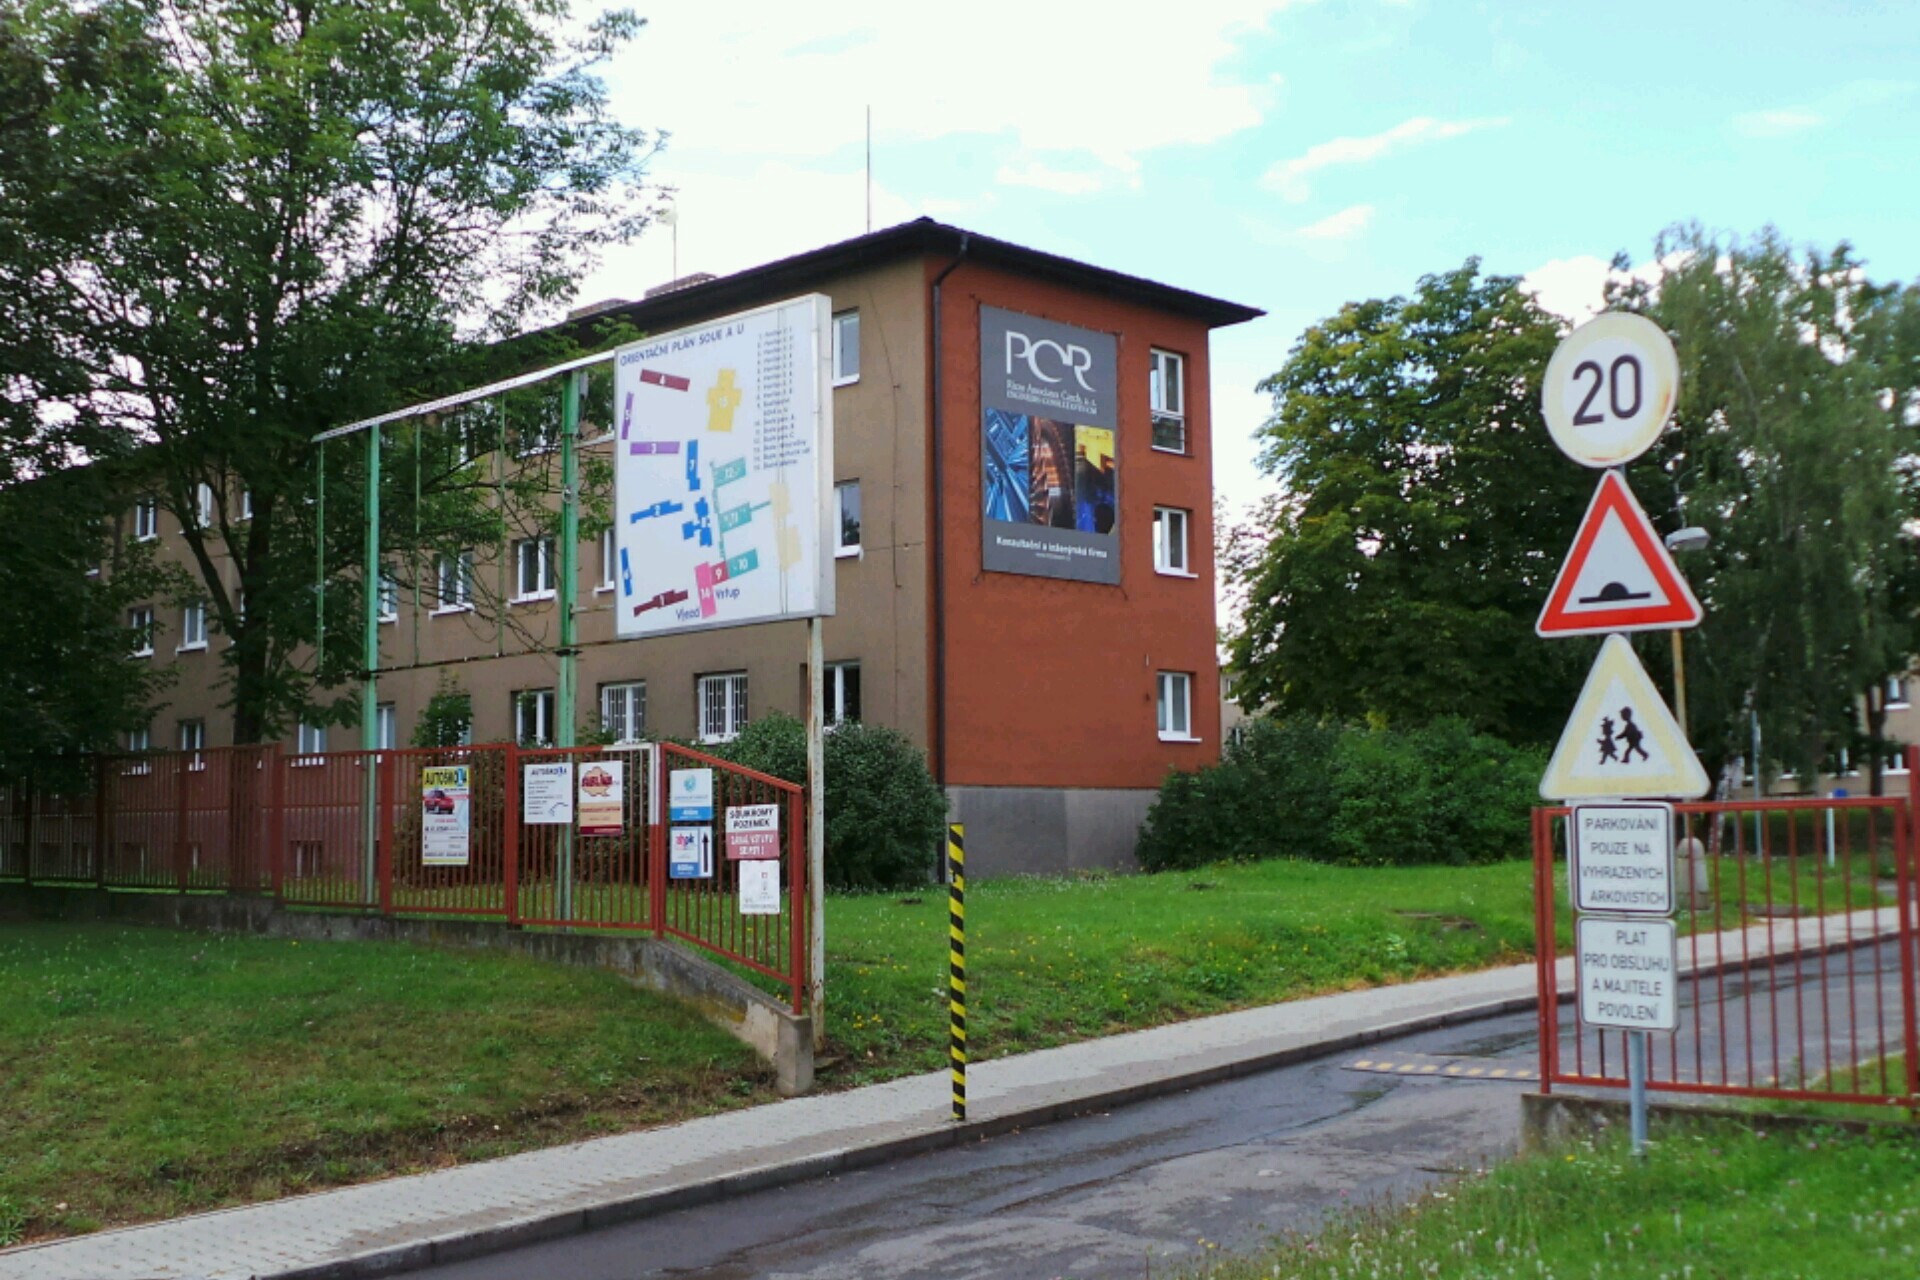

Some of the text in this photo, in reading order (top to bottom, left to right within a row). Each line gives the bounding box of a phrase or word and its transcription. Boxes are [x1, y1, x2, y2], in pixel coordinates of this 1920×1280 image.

[1573, 354, 1641, 426] 20
[1591, 841, 1652, 855] POUZE NA
[1584, 952, 1669, 972] PRO OBSLUHU
[1592, 977, 1662, 997] A MAJITELE
